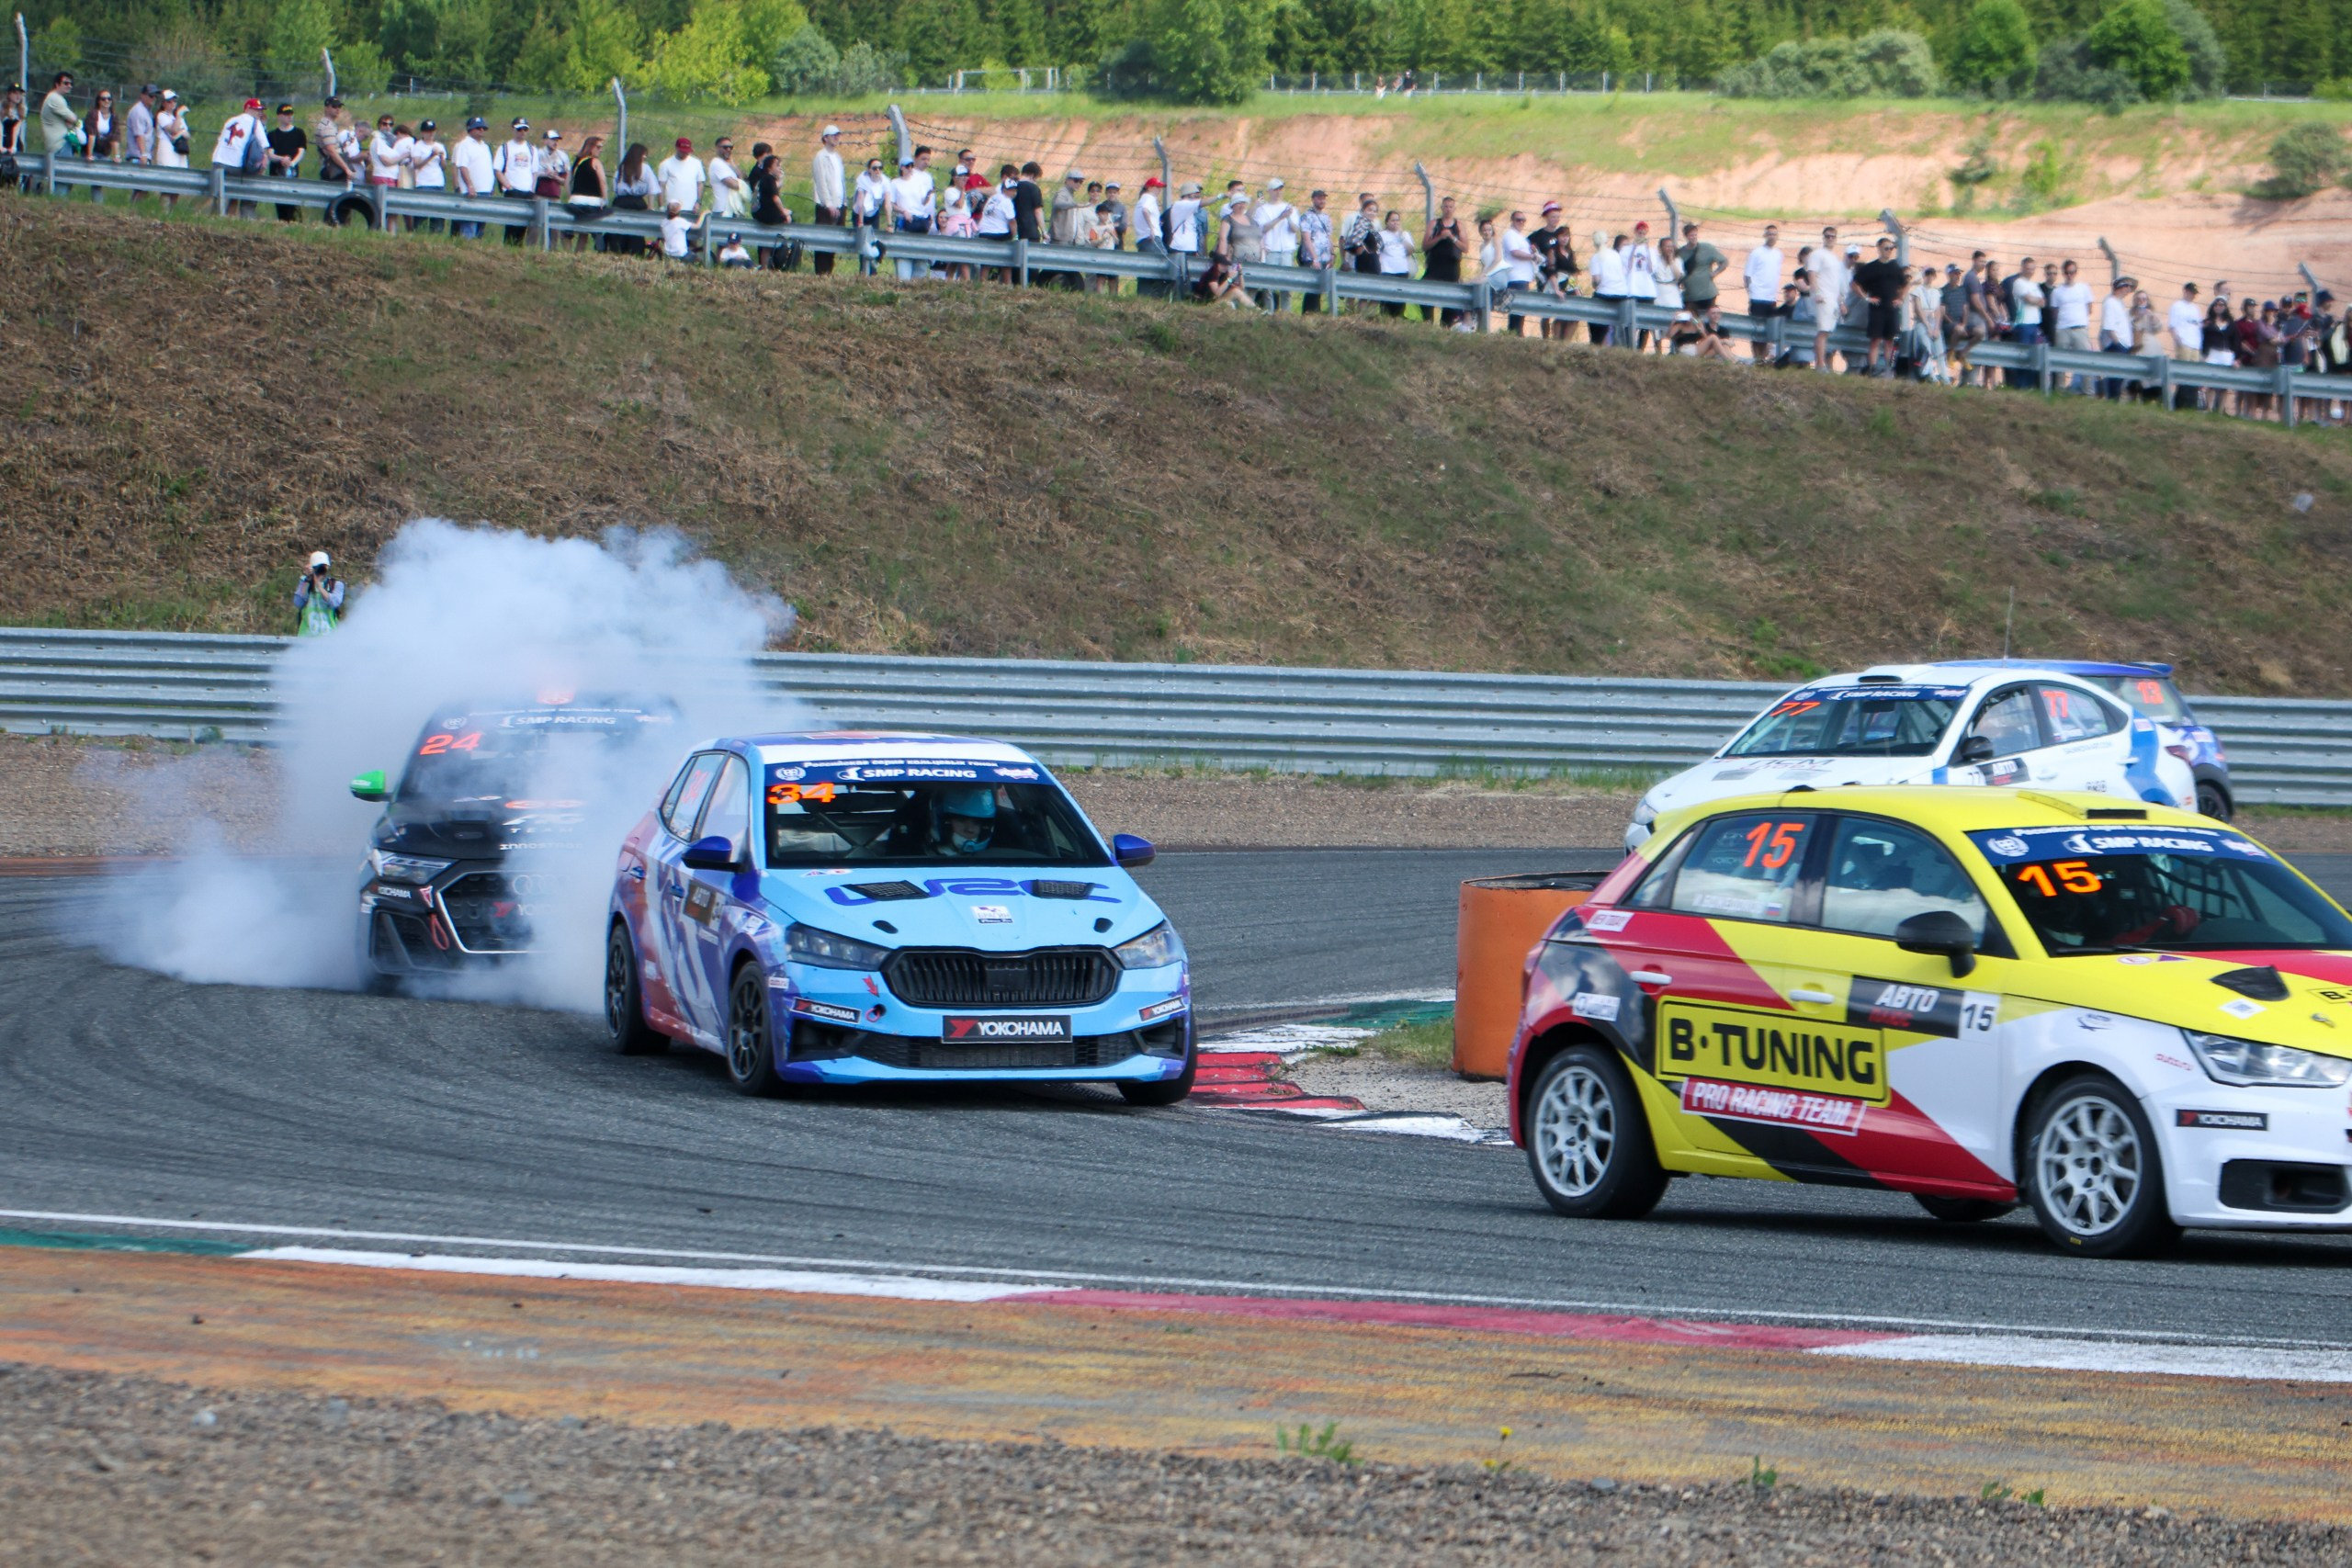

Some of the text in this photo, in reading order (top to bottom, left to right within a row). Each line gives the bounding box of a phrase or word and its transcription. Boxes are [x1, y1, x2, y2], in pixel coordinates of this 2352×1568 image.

[2042, 690, 2068, 718] 77
[2137, 681, 2164, 705] 13
[515, 716, 616, 725] SMP RACING
[1770, 701, 1821, 717] 77
[420, 731, 482, 756] 24
[862, 768, 978, 779] SMP RACING
[766, 781, 836, 805] 34
[1743, 821, 1805, 868] 15
[2091, 836, 2139, 849] SMP
[2138, 837, 2215, 852] RACING
[2018, 861, 2102, 897] 15
[1875, 984, 1940, 1012] АВТО
[810, 1003, 855, 1021] YOKOHAMA
[1963, 1002, 1996, 1032] 15
[978, 1021, 1065, 1036] YOKOHAMA
[1691, 1081, 1853, 1127] PRO RACING TEAM
[2197, 1112, 2264, 1128] YOKOHAMA
